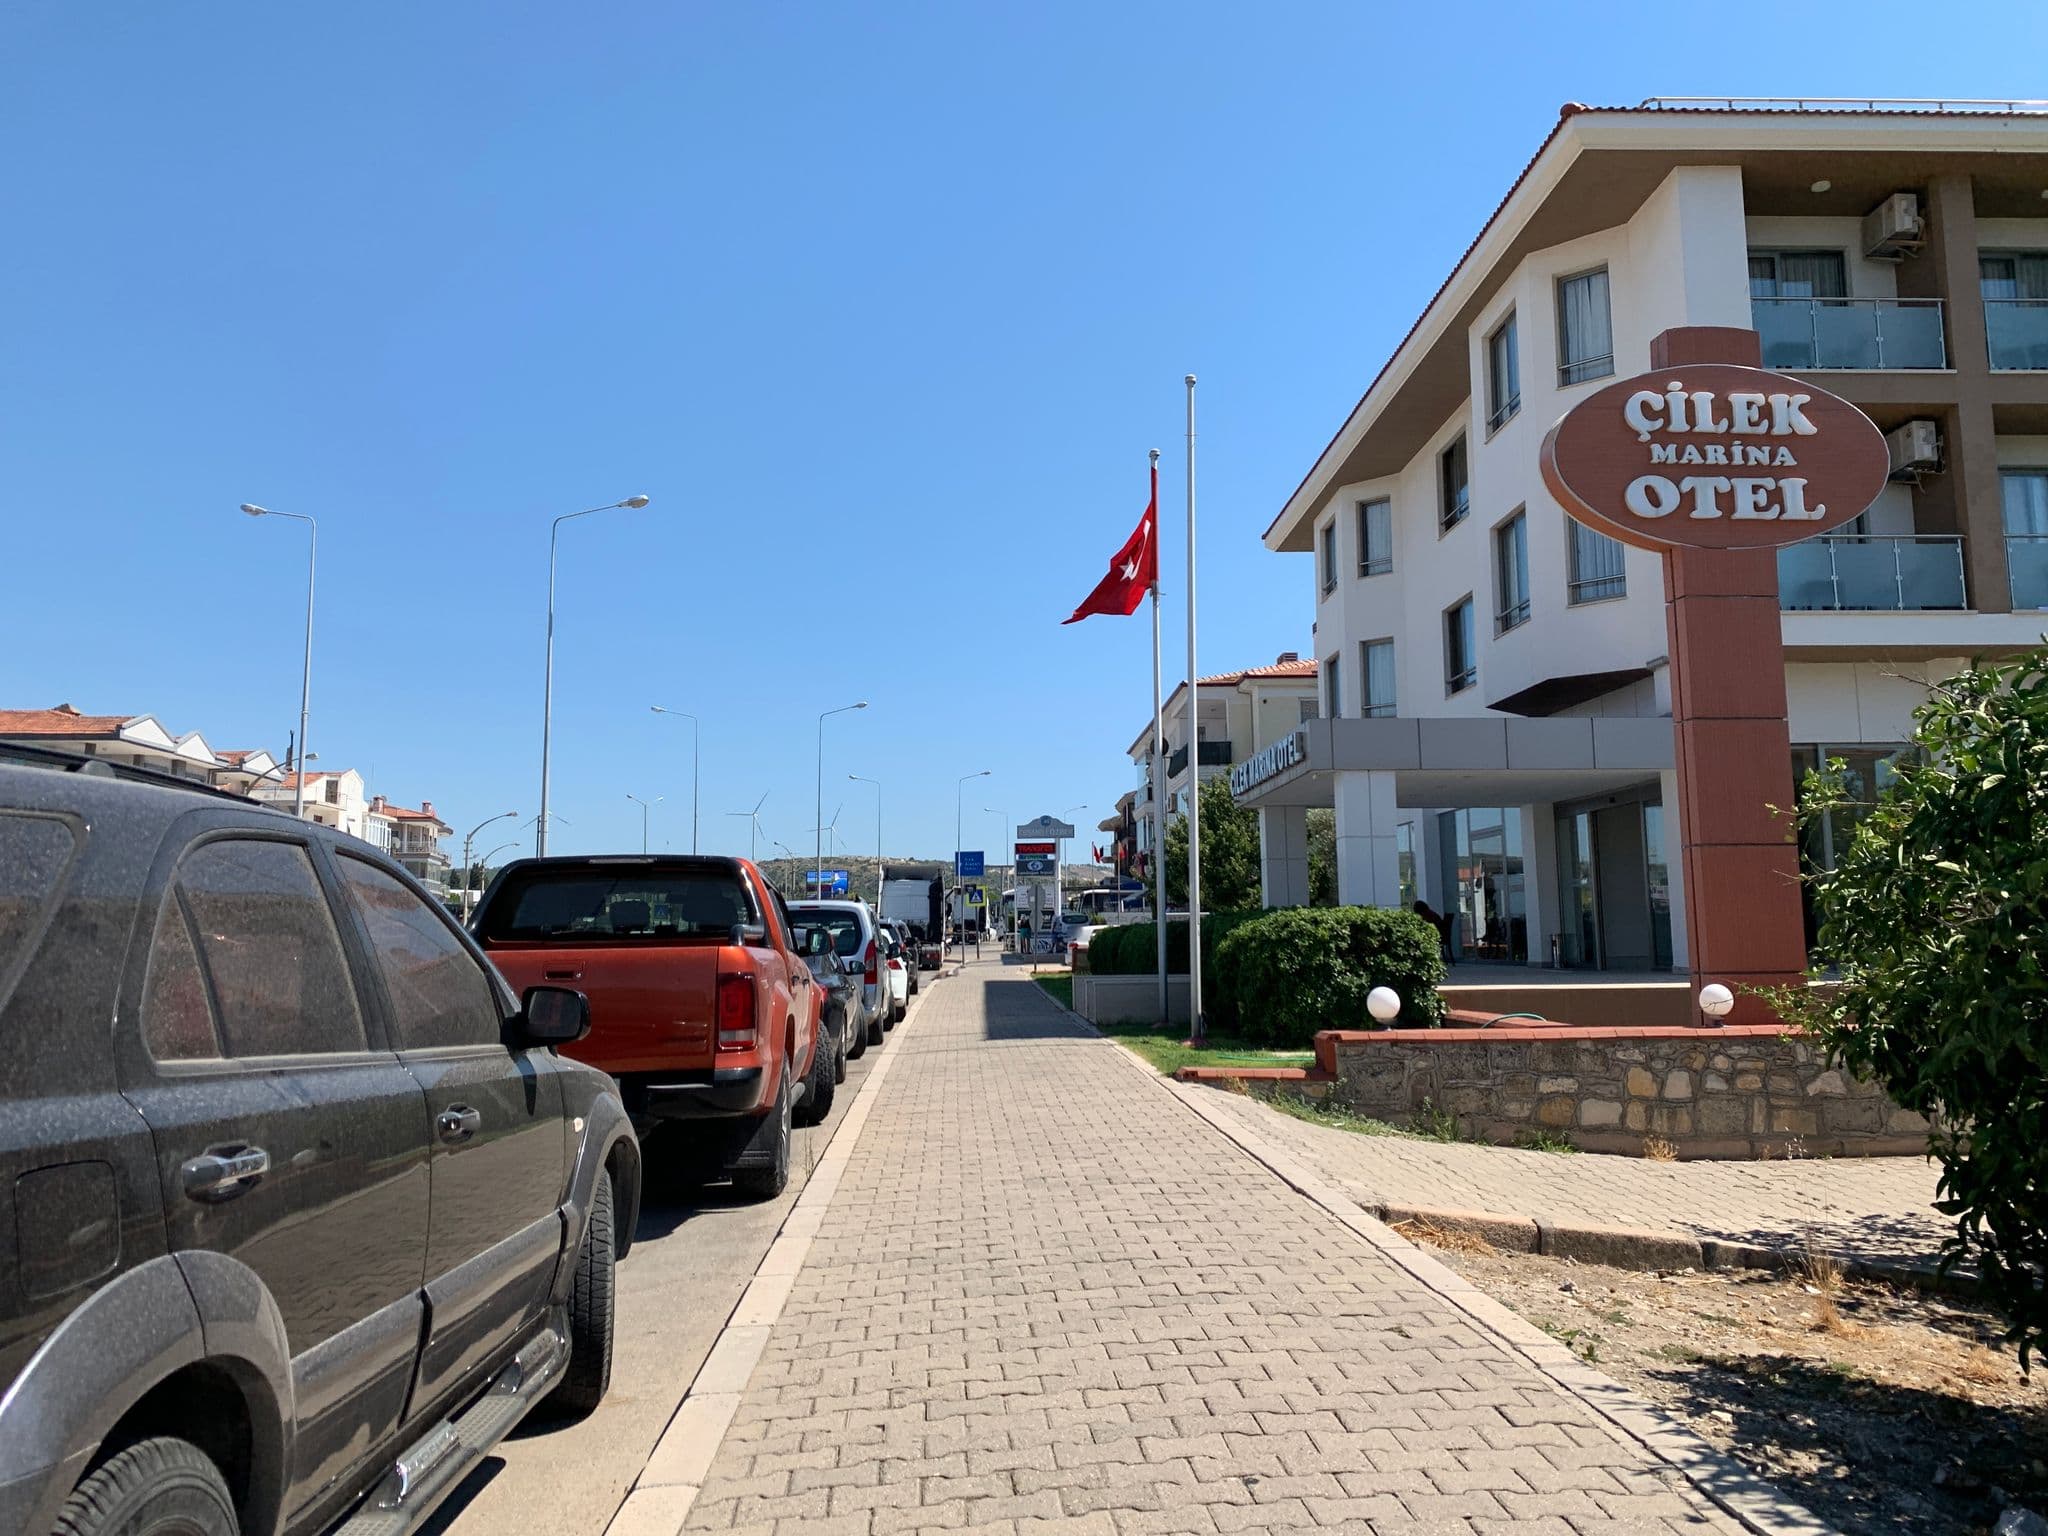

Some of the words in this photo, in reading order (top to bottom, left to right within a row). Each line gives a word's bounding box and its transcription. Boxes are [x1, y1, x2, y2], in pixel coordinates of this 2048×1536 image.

[1624, 381, 1818, 442] ÇİLEK
[1650, 440, 1798, 466] MARİNA
[1624, 475, 1827, 520] OTEL
[1278, 731, 1304, 770] OTEL
